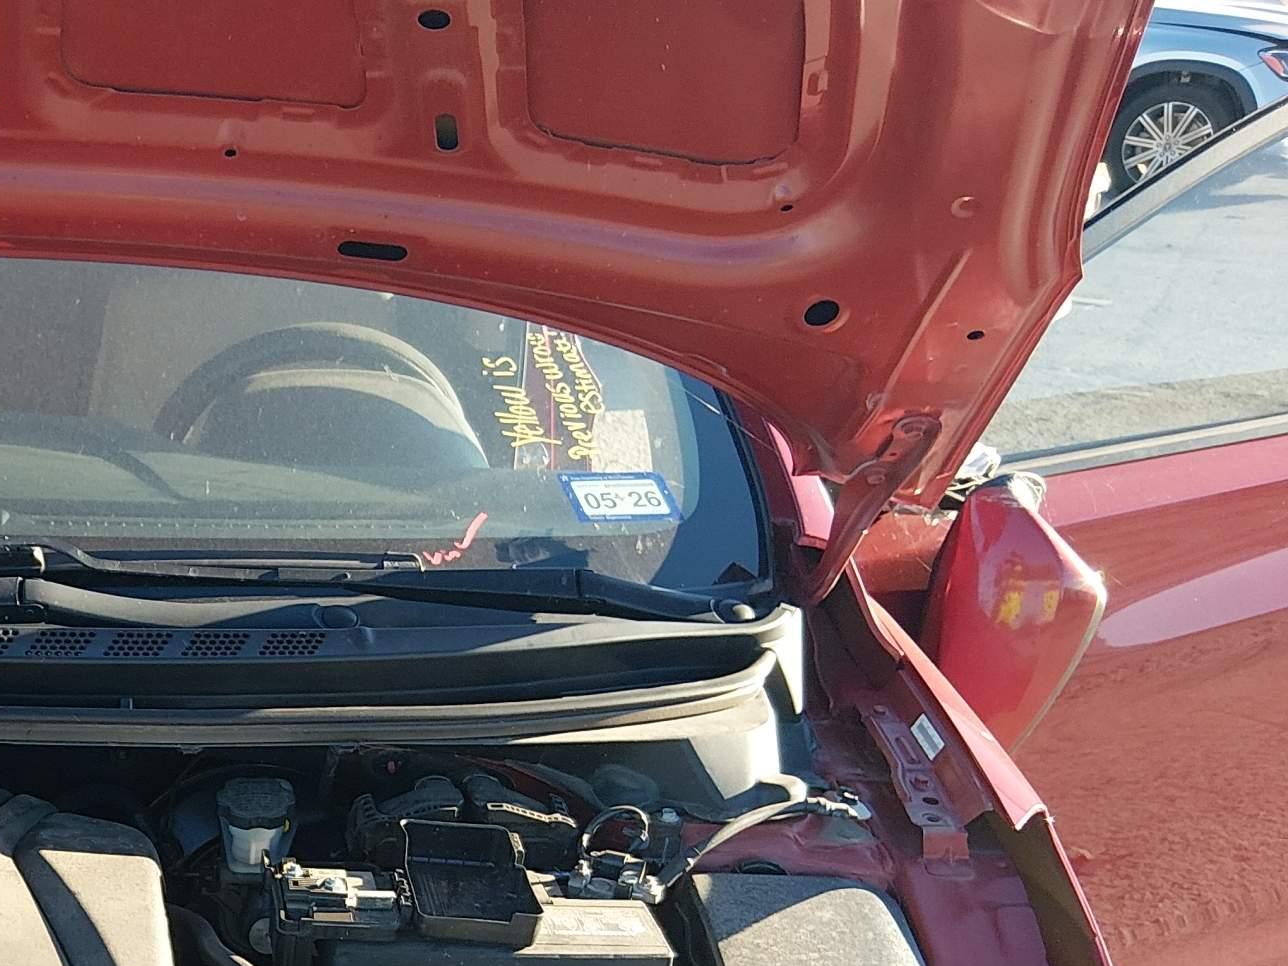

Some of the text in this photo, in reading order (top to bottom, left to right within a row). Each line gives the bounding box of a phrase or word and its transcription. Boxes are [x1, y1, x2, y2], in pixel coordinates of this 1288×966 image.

[481, 356, 562, 447] Yellow is
[584, 490, 662, 510] 05 26
